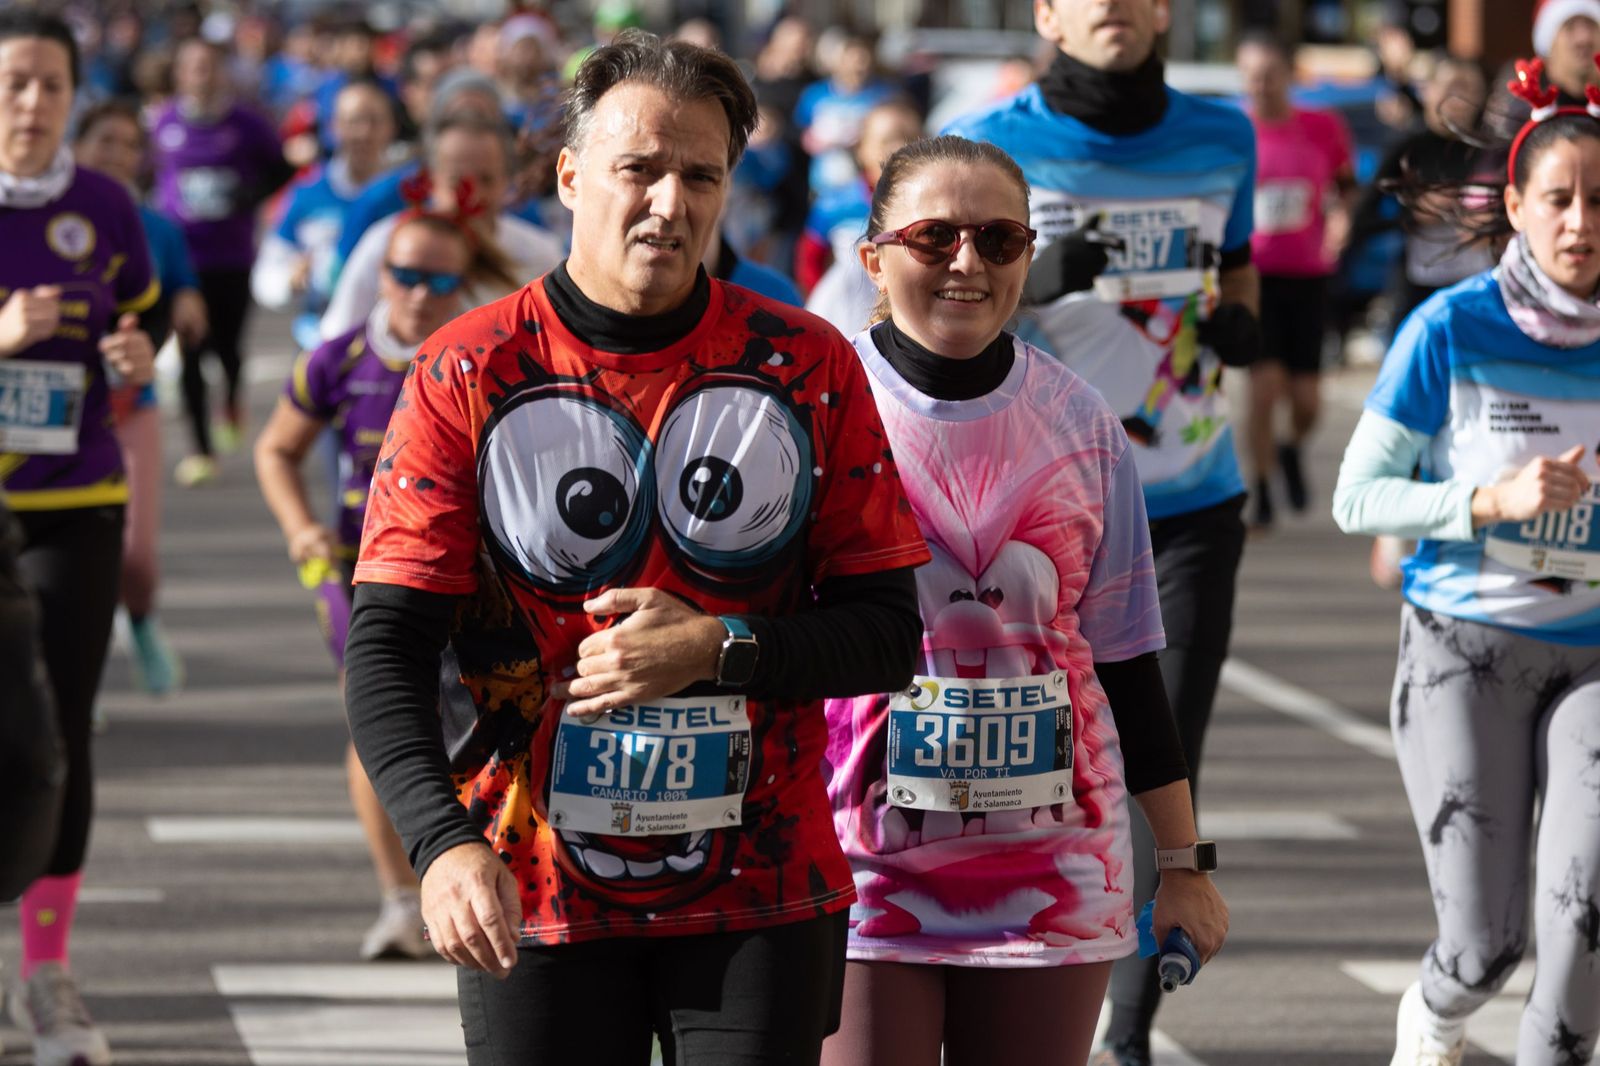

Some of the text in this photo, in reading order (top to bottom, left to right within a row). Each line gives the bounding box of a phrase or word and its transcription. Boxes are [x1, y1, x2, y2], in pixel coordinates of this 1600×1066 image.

[944, 684, 1056, 709] SETEL
[609, 706, 731, 729] SETEL
[914, 714, 1036, 768] 3609
[587, 730, 697, 790] 3178
[940, 767, 1010, 779] VA POR TI
[591, 786, 688, 801] CANARIO 100%
[973, 788, 1022, 799] Ayuntamiento
[984, 799, 1022, 808] Salamanca
[635, 812, 688, 823] Ayuntamiento
[635, 823, 686, 832] de Salamanca
